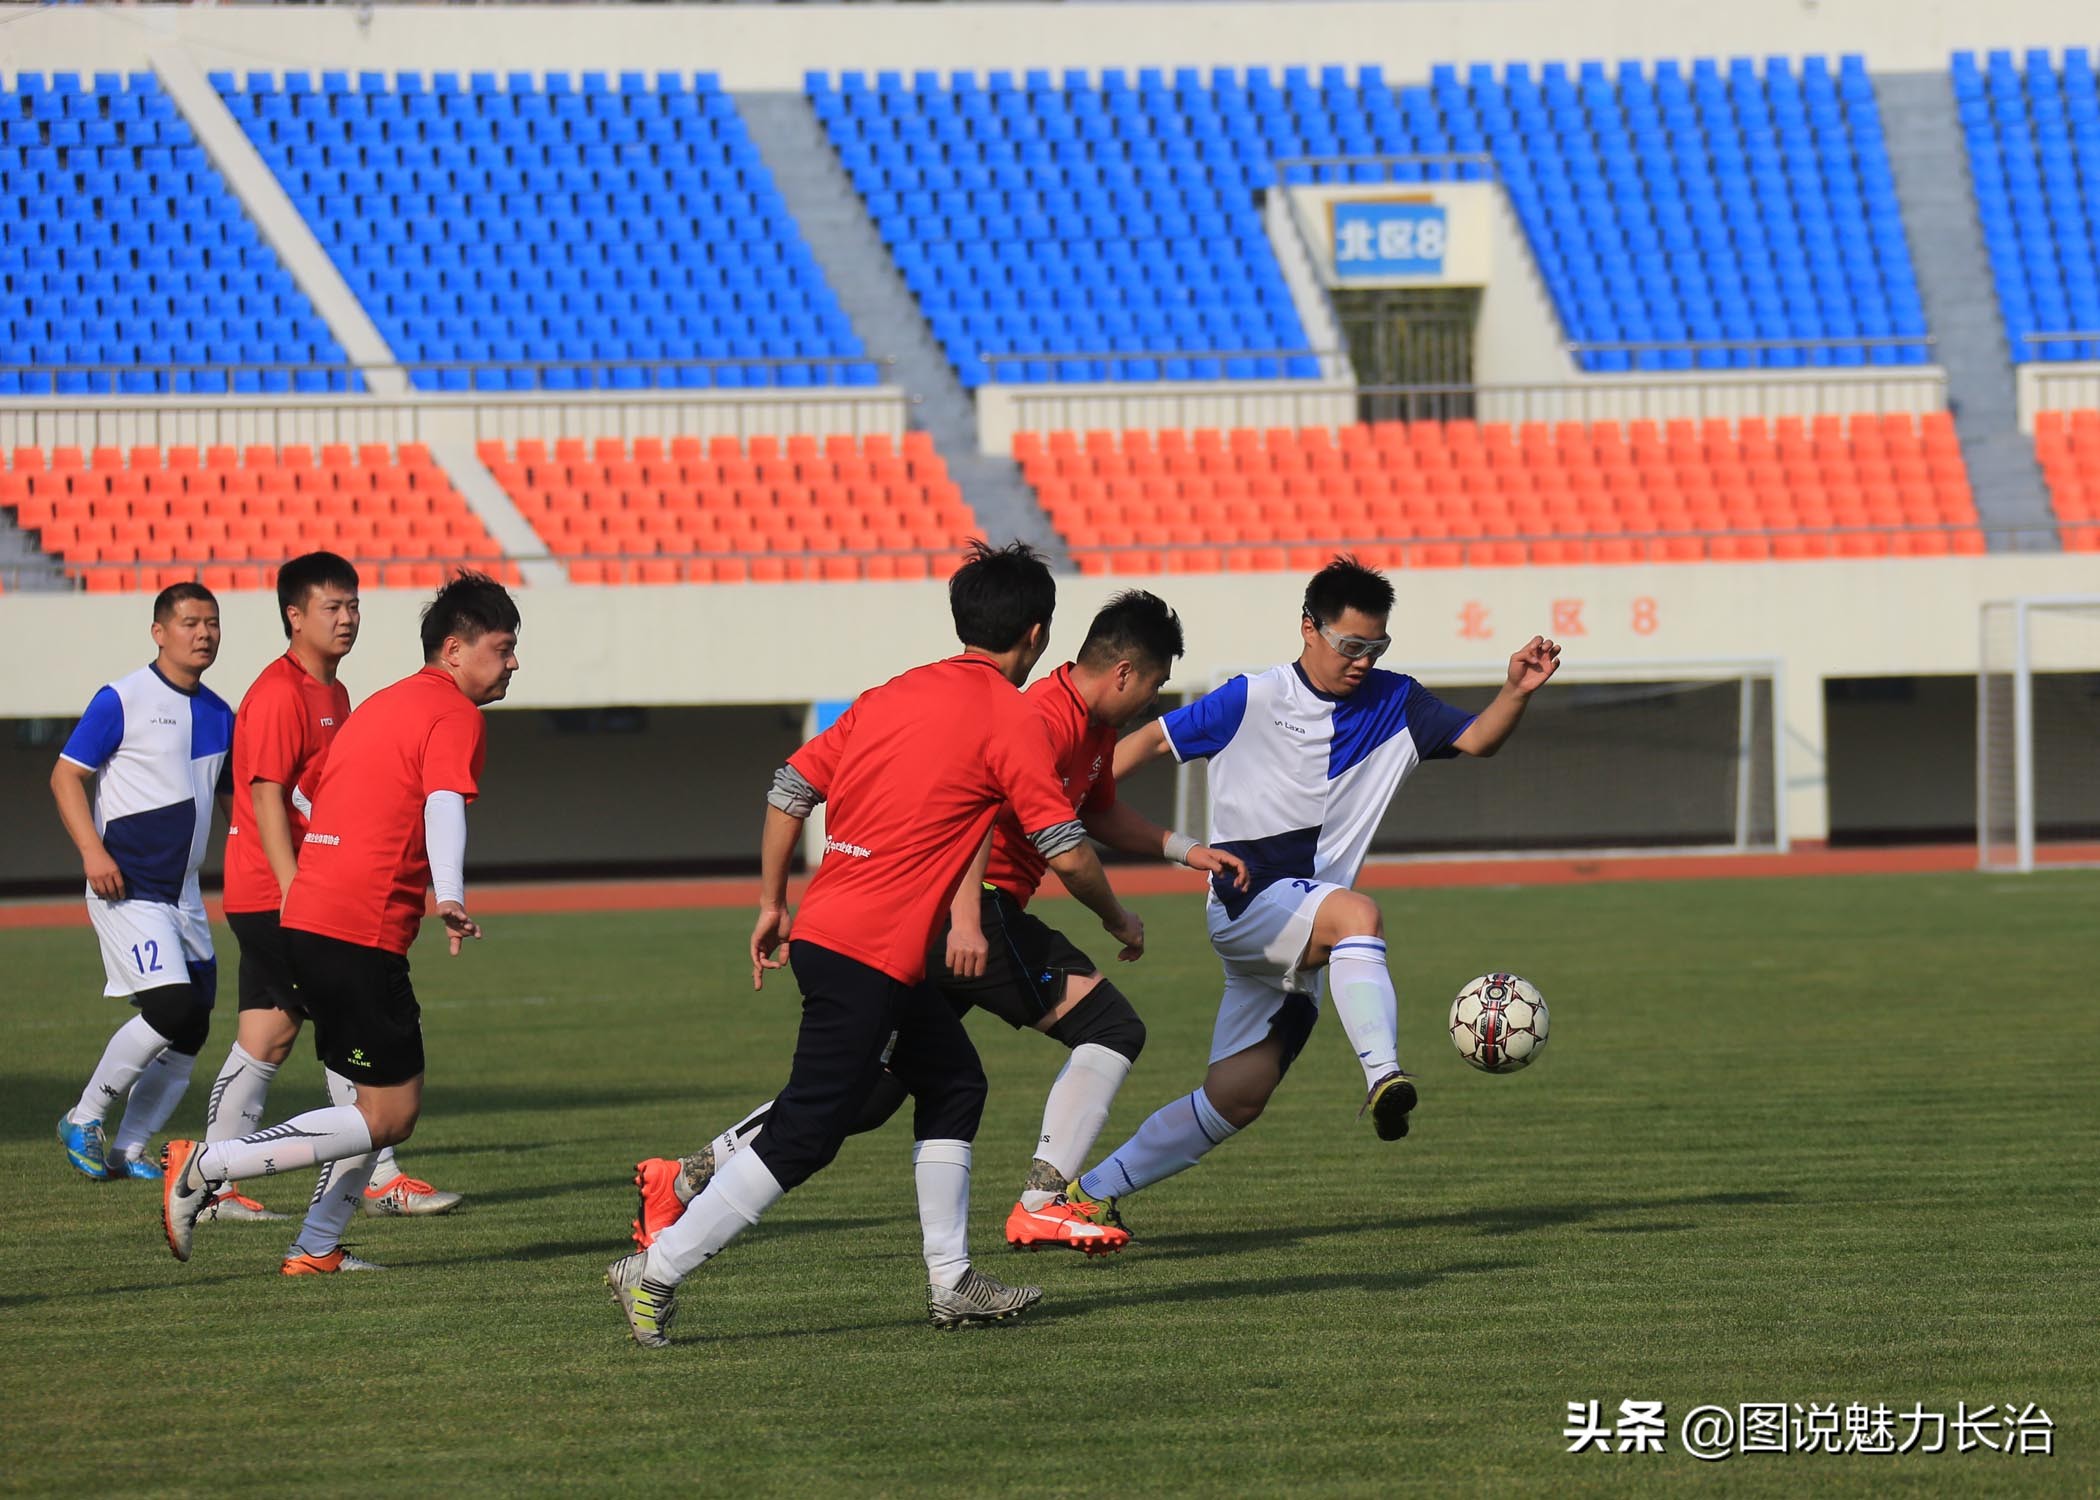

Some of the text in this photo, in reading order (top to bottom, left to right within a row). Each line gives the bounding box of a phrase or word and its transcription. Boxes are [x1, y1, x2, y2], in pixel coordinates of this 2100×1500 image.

[1336, 218, 1445, 260] 北区8
[1292, 879, 1319, 894] 2
[131, 940, 163, 974] 12
